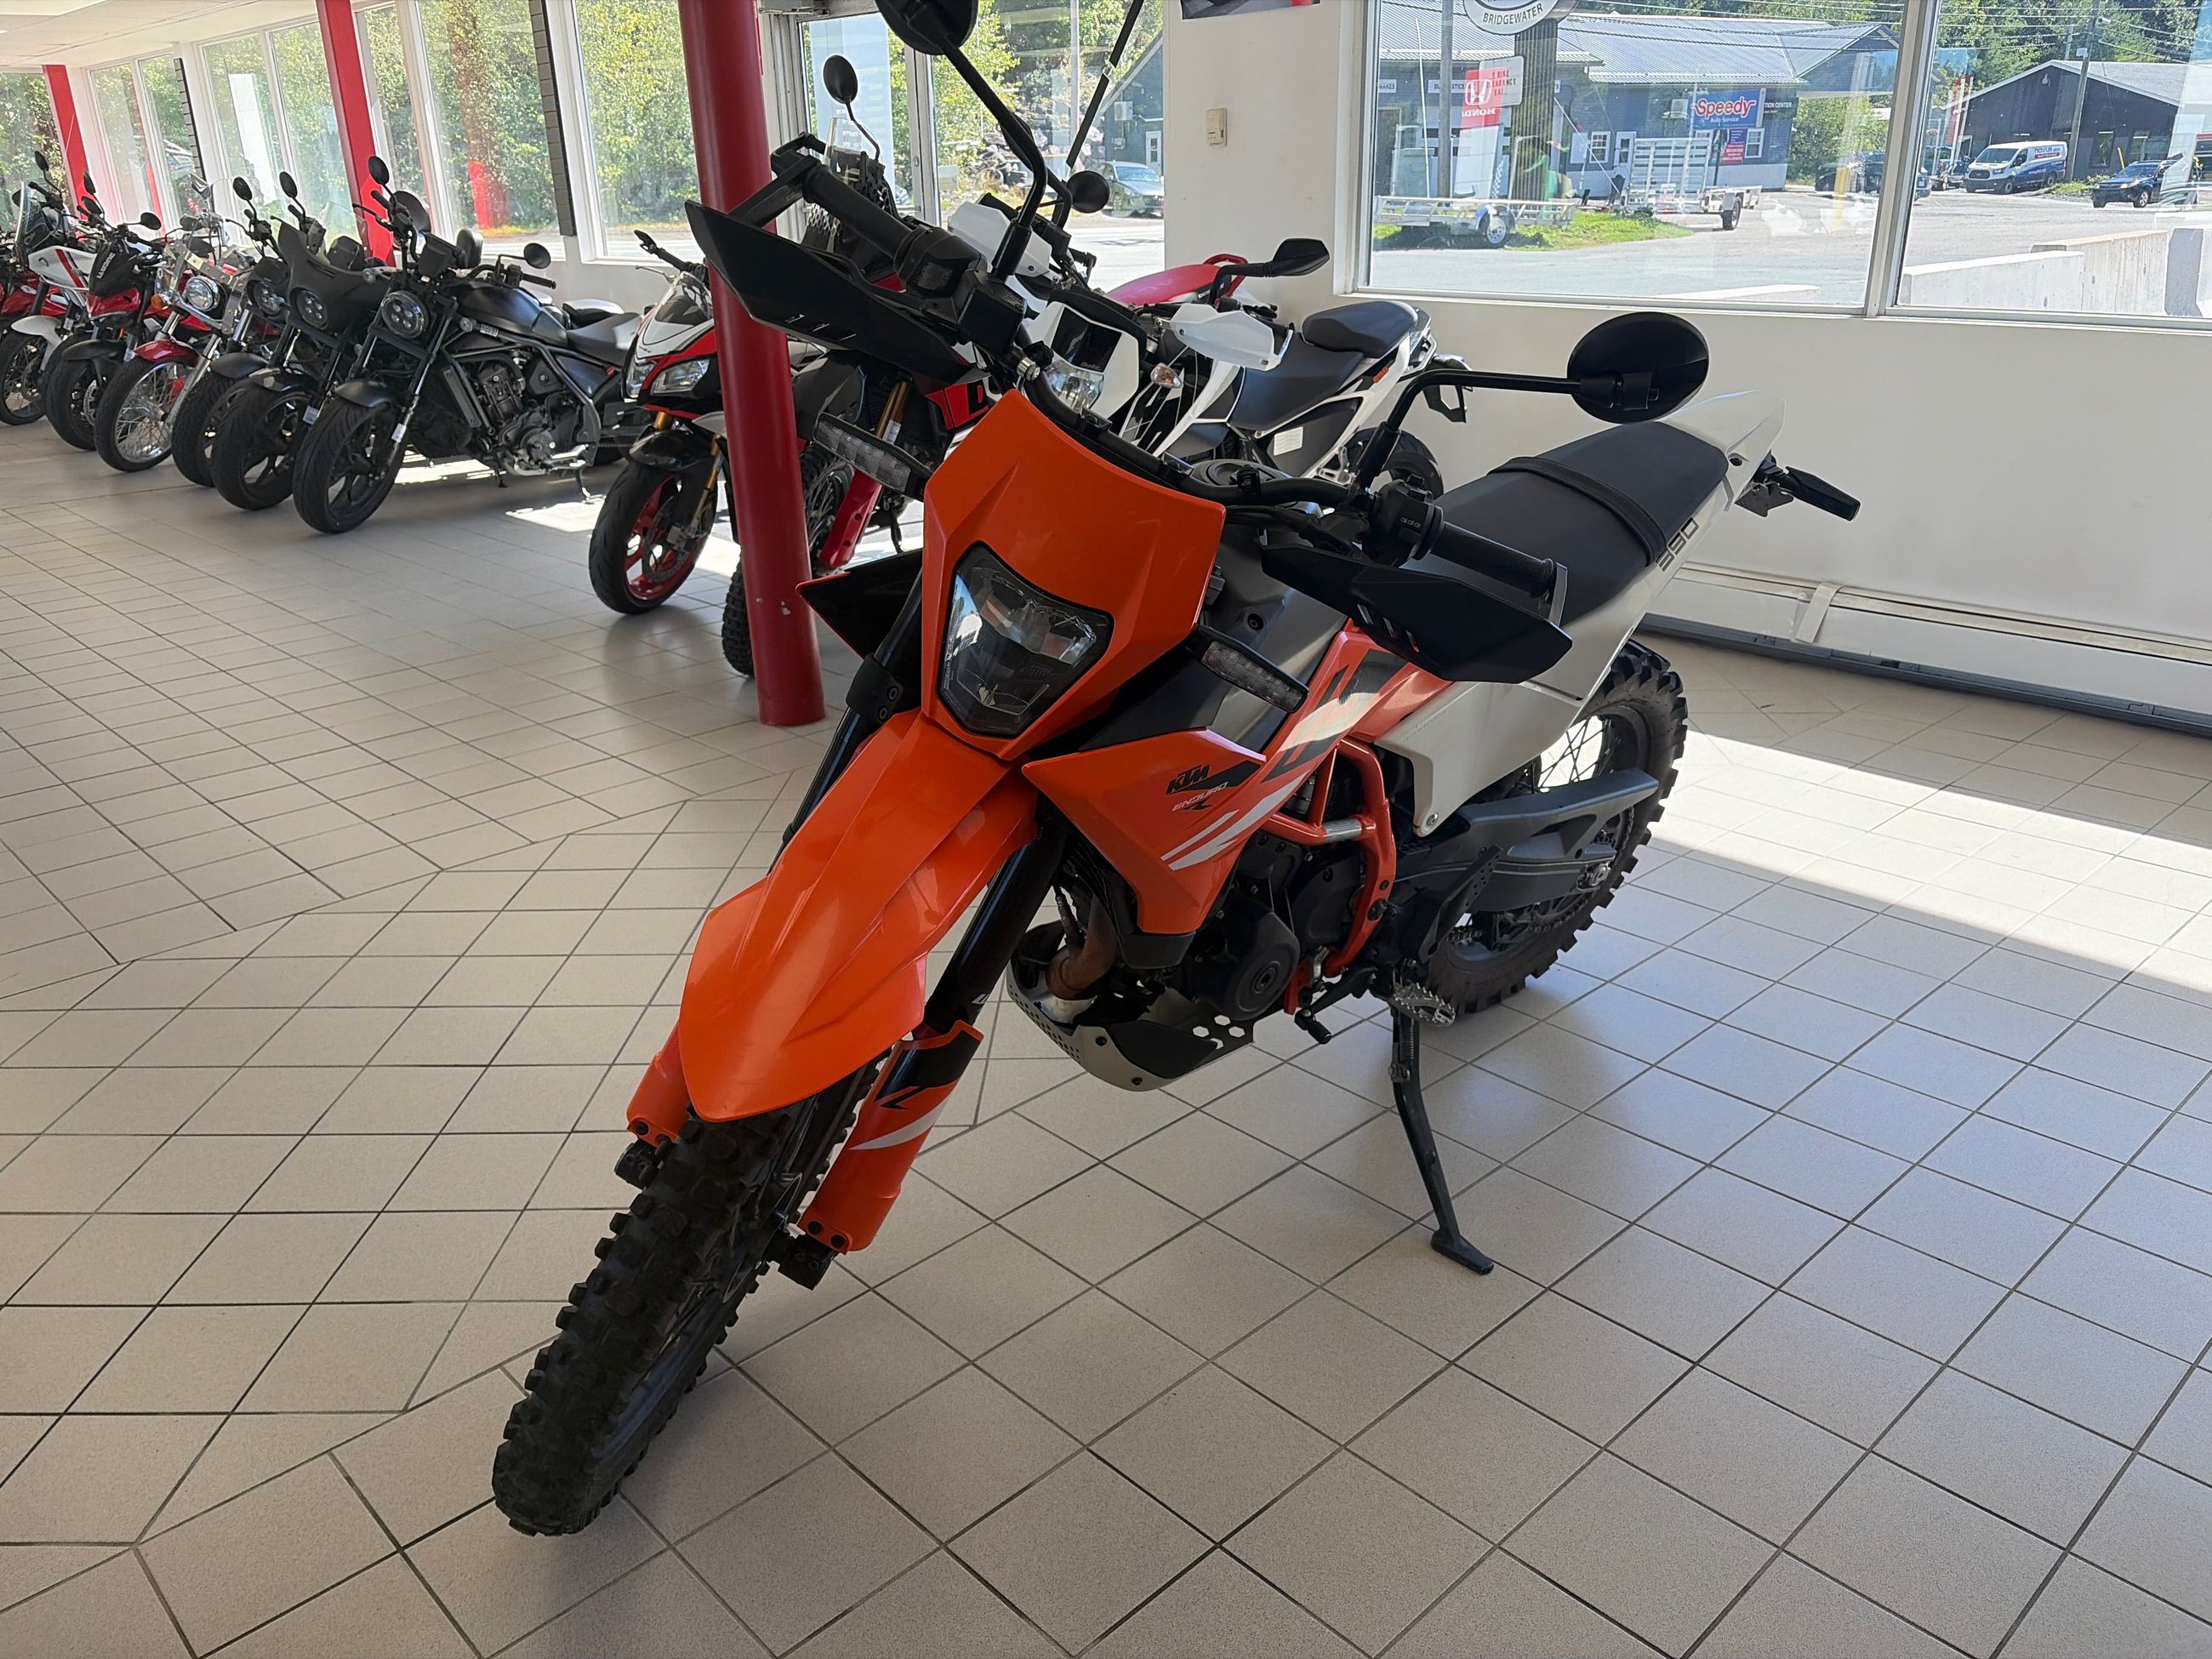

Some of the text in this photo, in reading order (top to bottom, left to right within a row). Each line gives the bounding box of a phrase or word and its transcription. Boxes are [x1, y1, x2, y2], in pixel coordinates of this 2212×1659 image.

[1483, 3, 1543, 25] BRIDGEWATER
[1692, 97, 1756, 118] Speedy
[1656, 517, 1699, 572] 390
[1166, 764, 1210, 795] KTM
[1172, 781, 1229, 812] ENDURO
